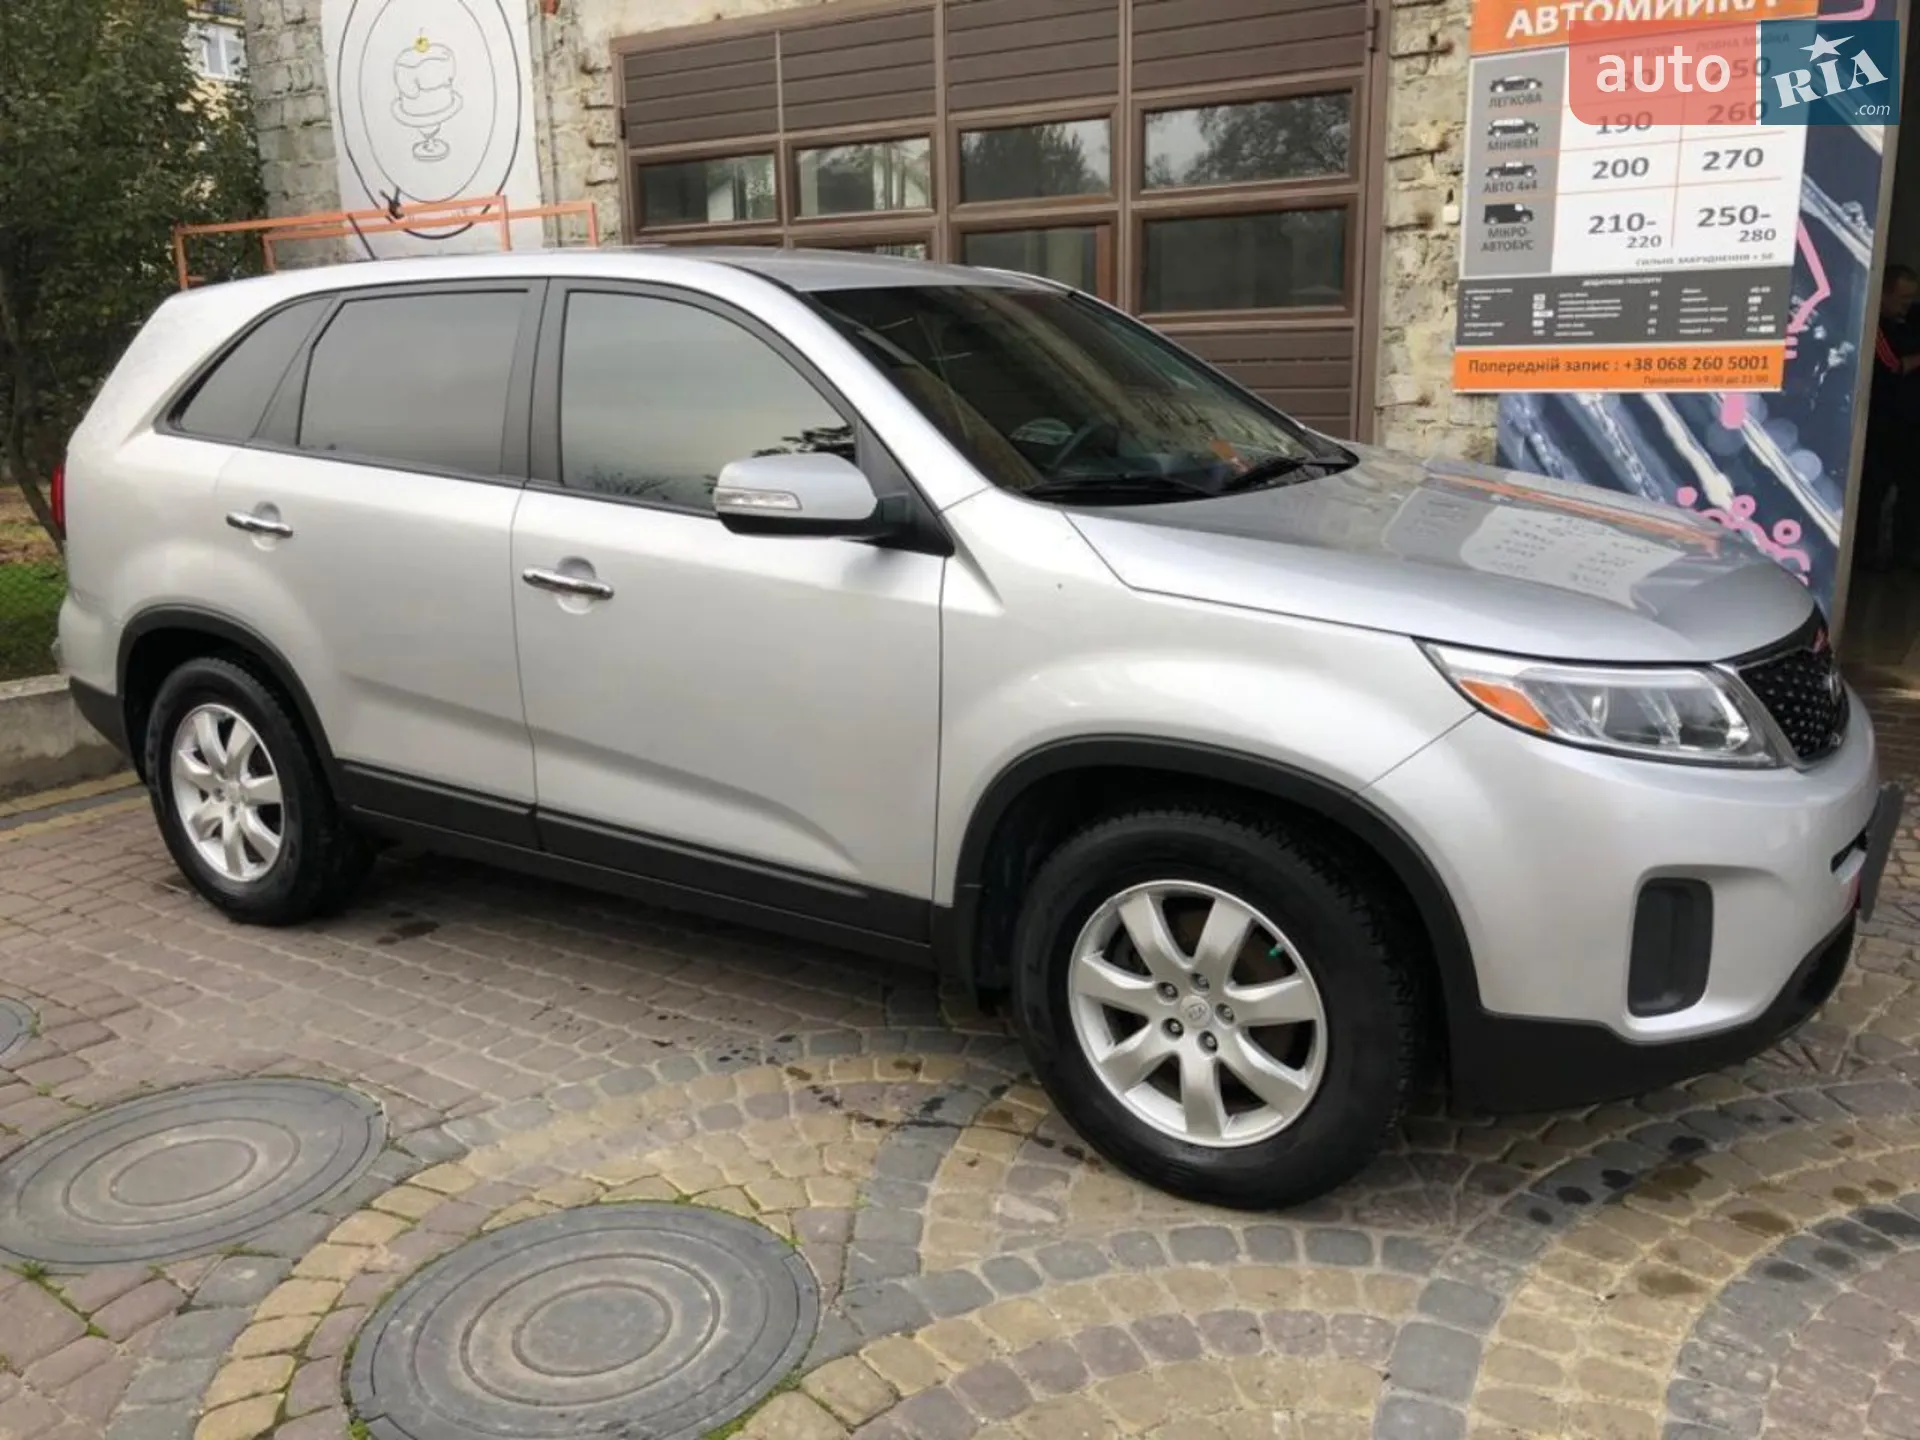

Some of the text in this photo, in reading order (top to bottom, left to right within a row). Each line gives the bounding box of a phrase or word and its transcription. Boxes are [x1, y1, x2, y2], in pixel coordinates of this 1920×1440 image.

[1506, 0, 1779, 39] АВТОМИ
[1488, 93, 1542, 108] ЛЕГКОВА
[1596, 111, 1654, 136] 190
[1706, 100, 1768, 125] 260
[1592, 157, 1650, 180] 200
[1702, 147, 1765, 171] 270
[1483, 181, 1515, 194] АВТО
[1588, 212, 1657, 235] 210-
[1697, 205, 1771, 228] 250-
[1480, 238, 1535, 252] АВТОБУС
[1626, 235, 1662, 249] 220
[1738, 228, 1777, 243] 280
[1468, 356, 1560, 377] Попередній
[1564, 361, 1610, 373] запис
[1624, 357, 1653, 370] +38
[1657, 357, 1687, 370] 068
[1692, 356, 1723, 369] 260
[1727, 355, 1769, 369] 5001
